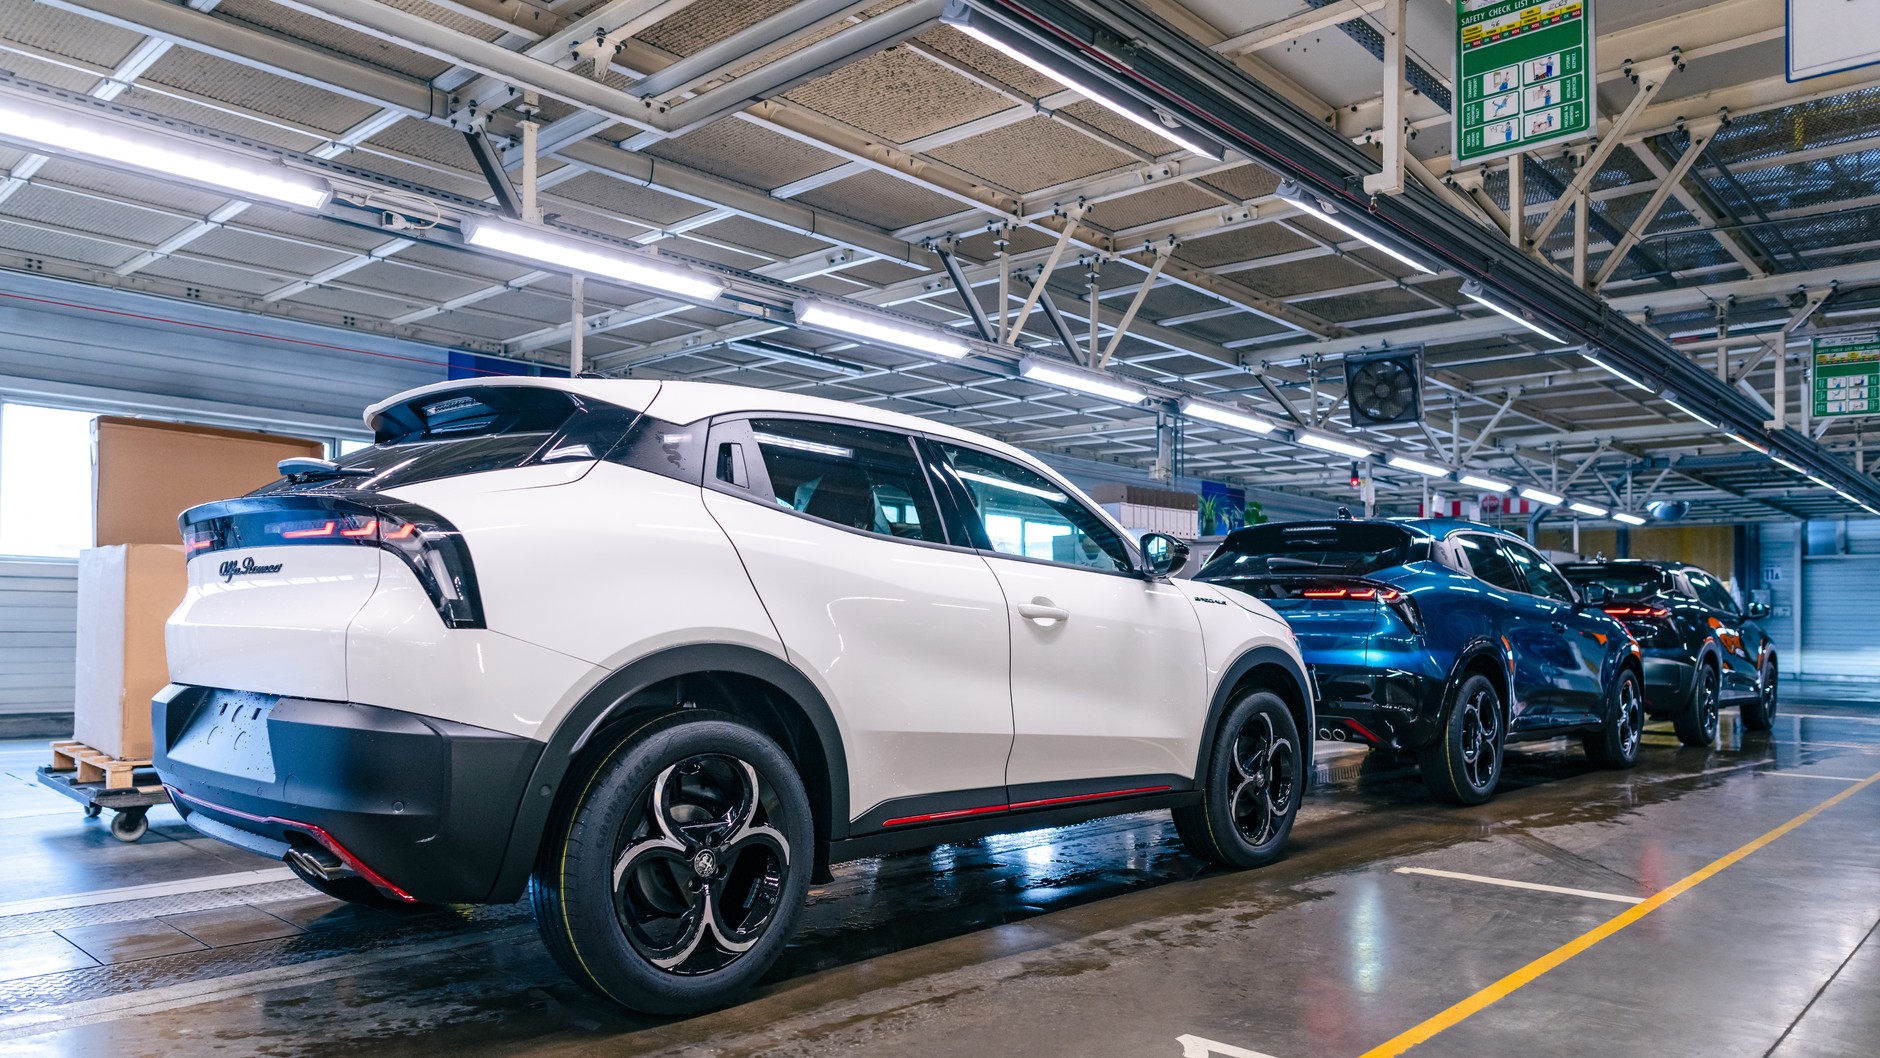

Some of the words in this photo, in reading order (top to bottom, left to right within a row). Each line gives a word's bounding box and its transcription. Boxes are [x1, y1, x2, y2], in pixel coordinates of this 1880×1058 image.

[1461, 12, 1485, 26] SAFETY
[1488, 4, 1511, 17] CHECK
[1514, 0, 1528, 10] LIST
[219, 560, 241, 583] Alfa
[242, 557, 283, 575] Romeo
